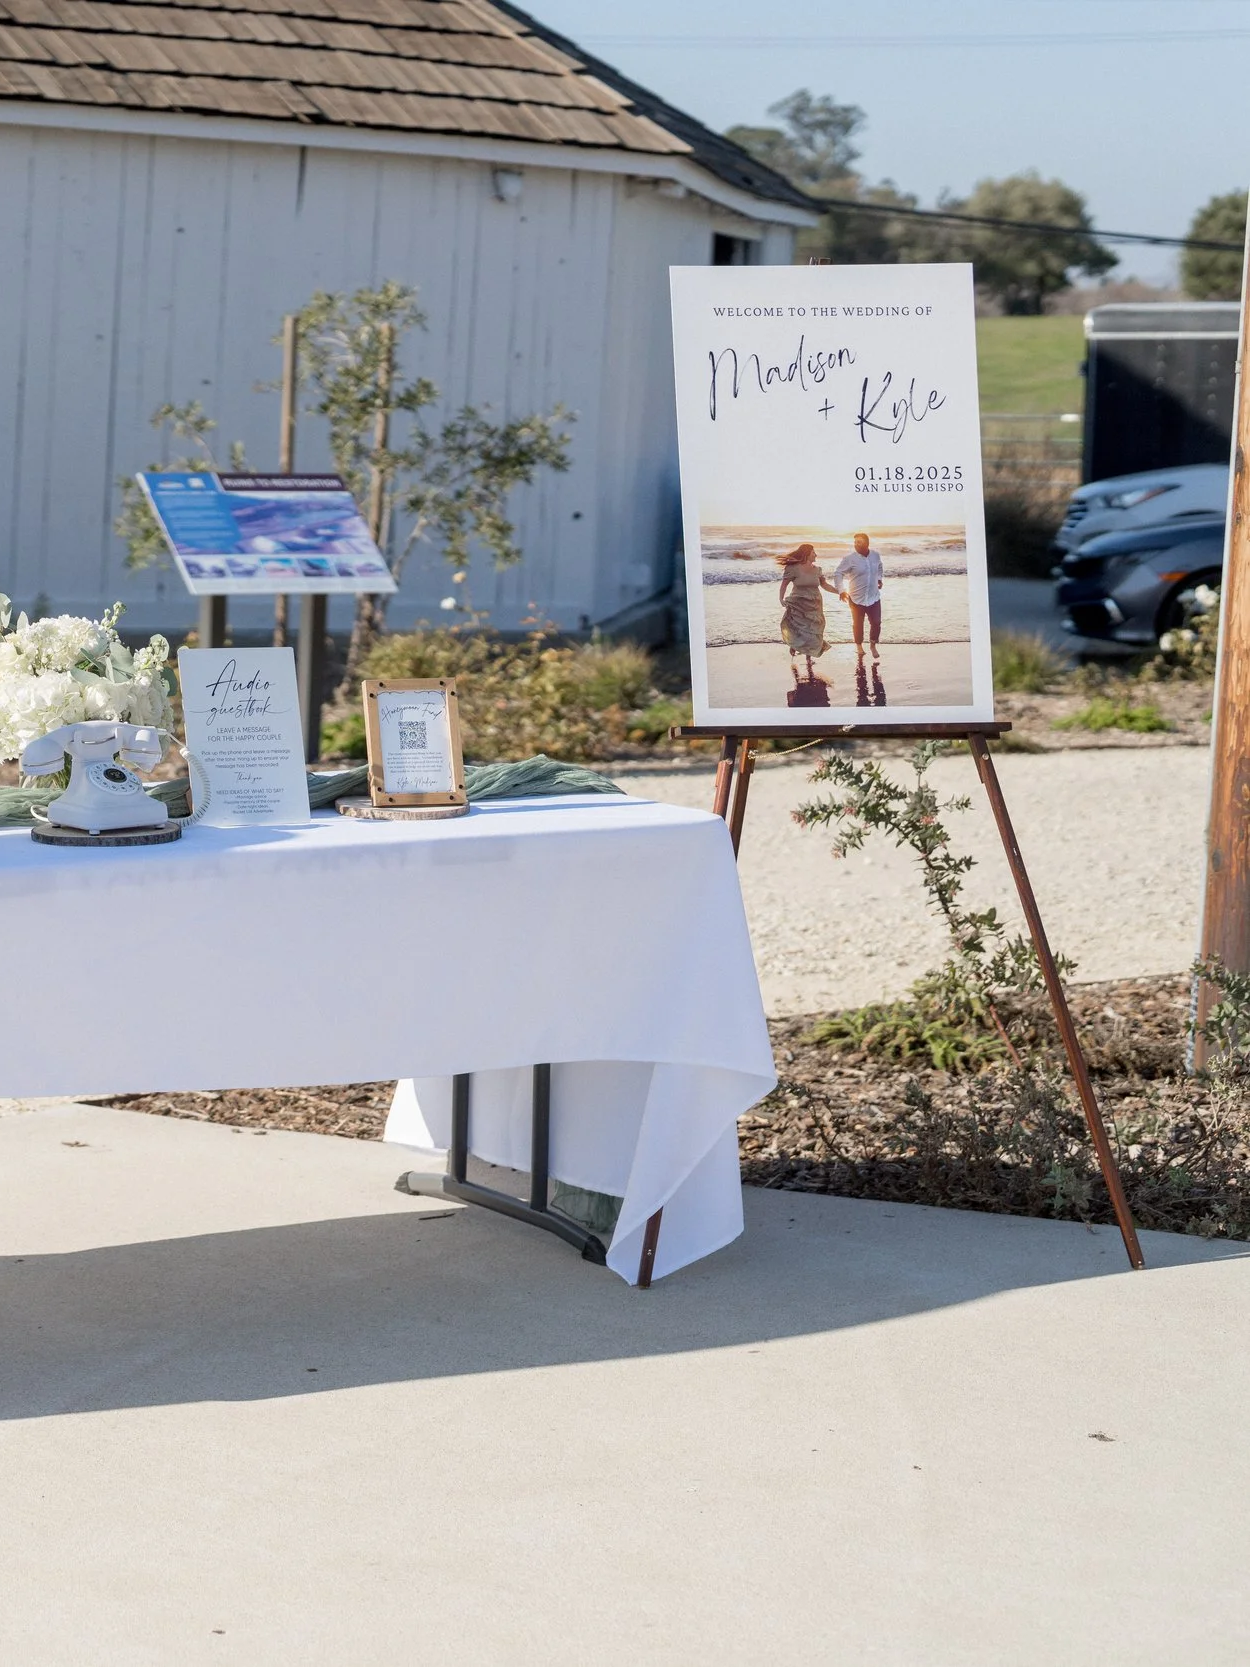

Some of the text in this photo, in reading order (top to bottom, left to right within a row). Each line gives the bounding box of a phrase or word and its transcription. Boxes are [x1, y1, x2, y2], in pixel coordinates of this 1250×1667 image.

[713, 306, 933, 317] WELCOME TO THE WEDDING OF
[709, 335, 856, 421] Madison
[818, 372, 947, 443] + Kyle
[855, 466, 963, 481] 01.18.2025
[855, 482, 964, 493] SAN LUIS OBISPO
[206, 659, 276, 706] Audio
[193, 696, 287, 727] guestbook
